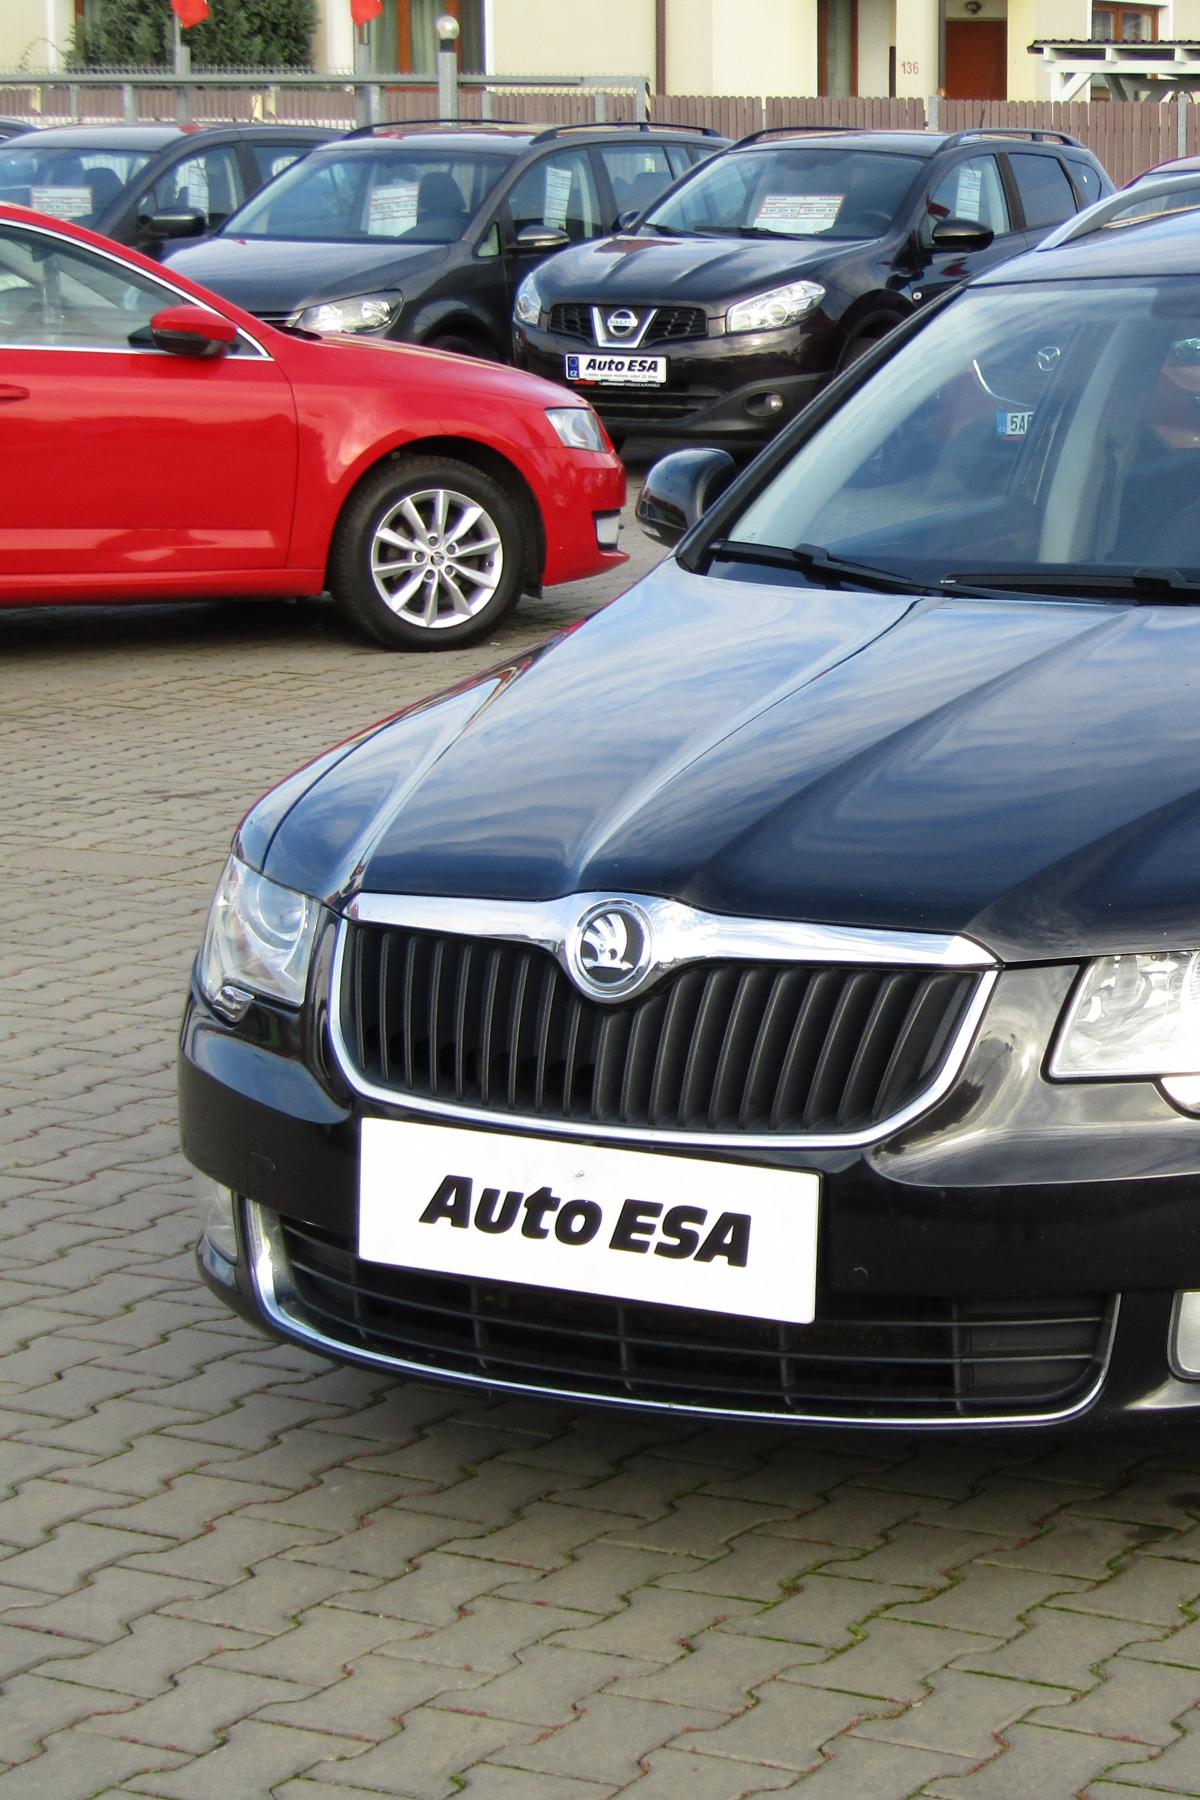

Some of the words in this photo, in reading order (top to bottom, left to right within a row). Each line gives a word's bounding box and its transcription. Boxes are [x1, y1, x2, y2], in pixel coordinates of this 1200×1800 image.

[901, 61, 919, 74] 136
[585, 358, 625, 372] Auto
[627, 360, 659, 373] ESA
[418, 1174, 602, 1246] Auto
[608, 1198, 752, 1268] ESA
